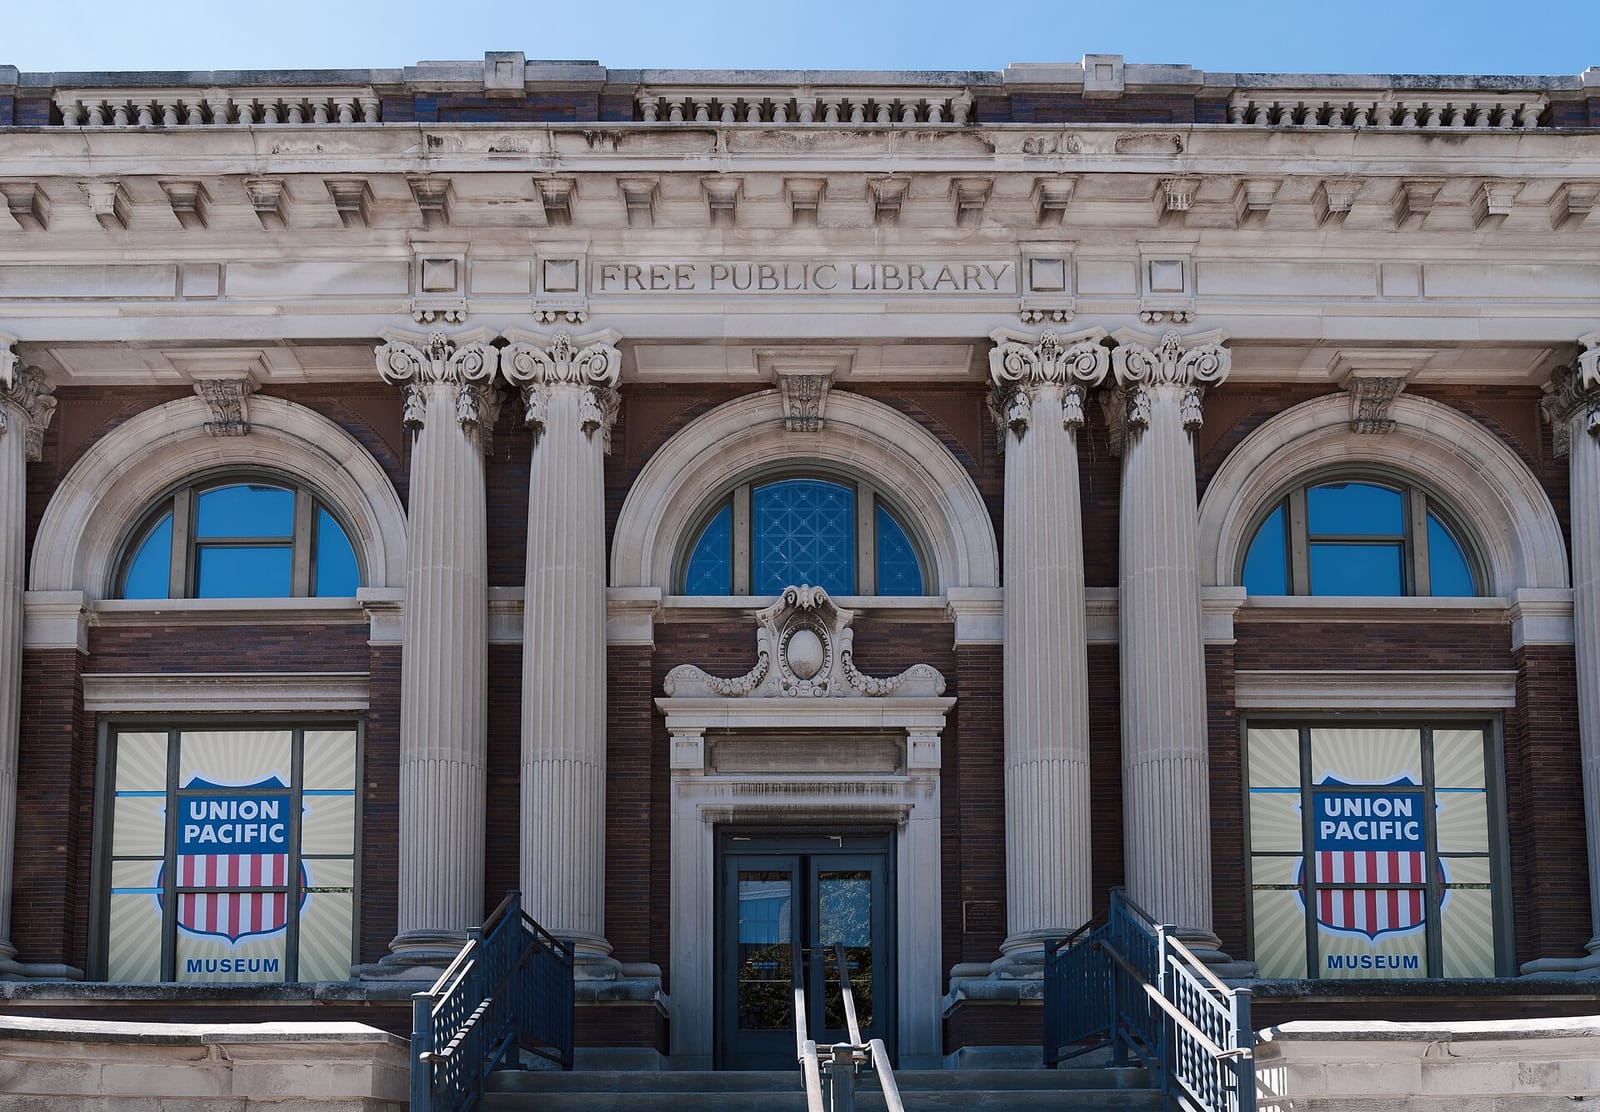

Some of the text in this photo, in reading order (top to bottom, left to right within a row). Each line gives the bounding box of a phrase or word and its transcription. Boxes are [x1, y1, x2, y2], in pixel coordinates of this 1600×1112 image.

[600, 264, 1011, 291] FREE PUBLIC LIBRARY
[190, 801, 279, 820] UNION
[1324, 798, 1413, 817] UNION
[184, 824, 284, 843] PACIFIC
[1320, 821, 1419, 840] PACIFIC
[186, 959, 279, 973] MUSEUM
[1327, 955, 1419, 969] MUSEUM
